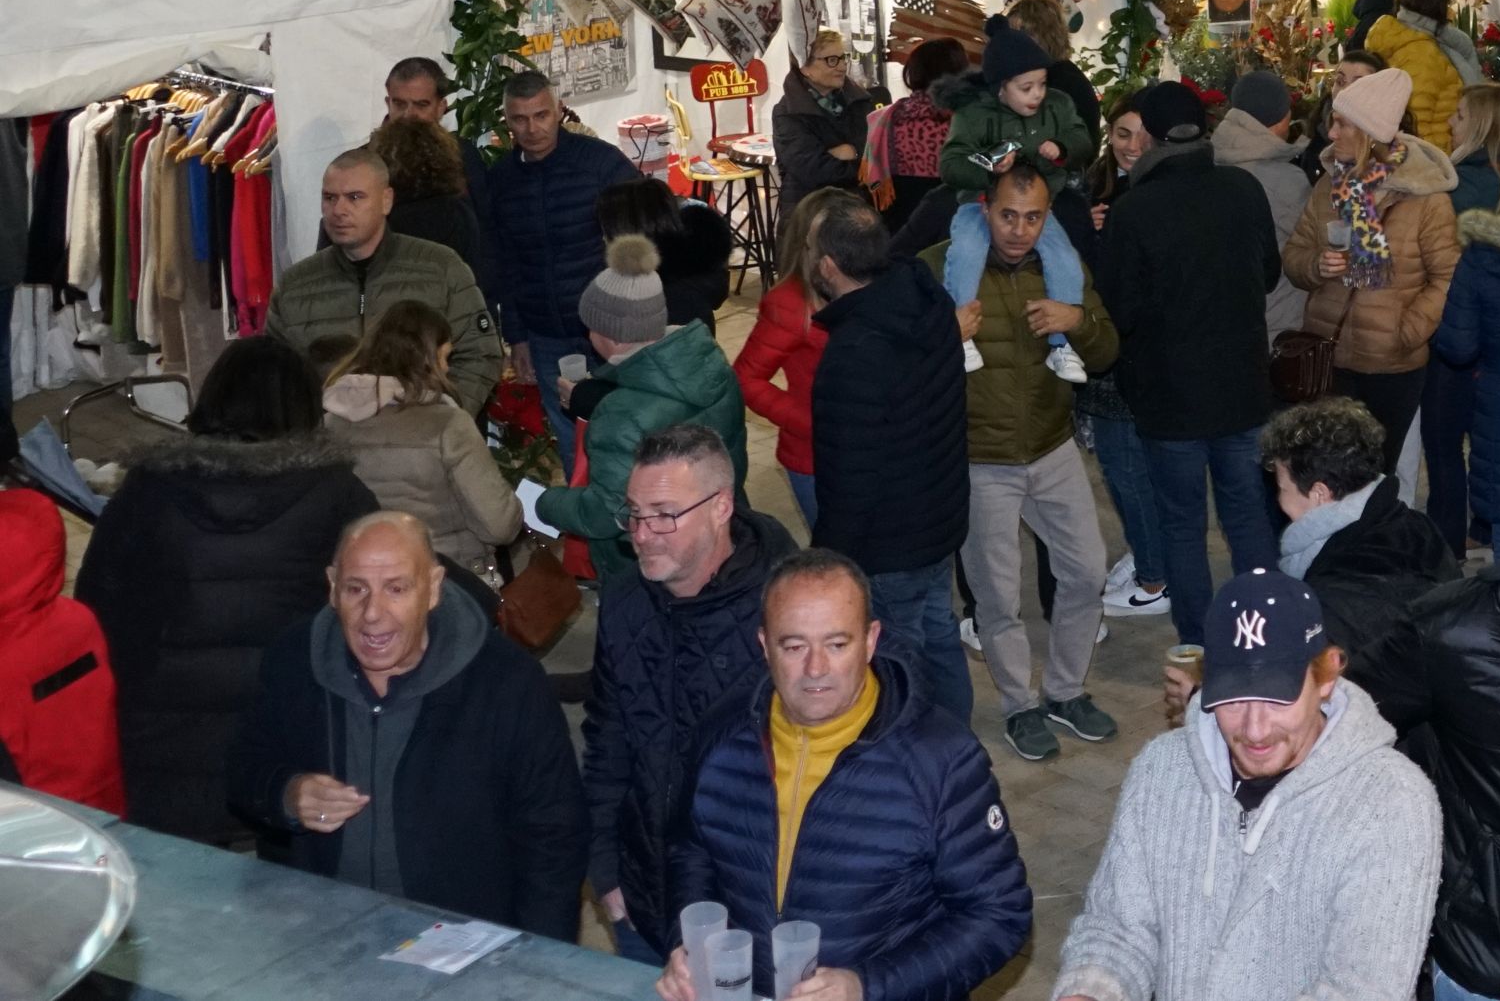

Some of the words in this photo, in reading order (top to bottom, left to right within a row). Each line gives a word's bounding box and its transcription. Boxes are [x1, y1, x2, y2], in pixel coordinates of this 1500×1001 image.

[561, 20, 622, 48] YORK
[710, 87, 728, 97] PUB
[1233, 609, 1266, 650] NY
